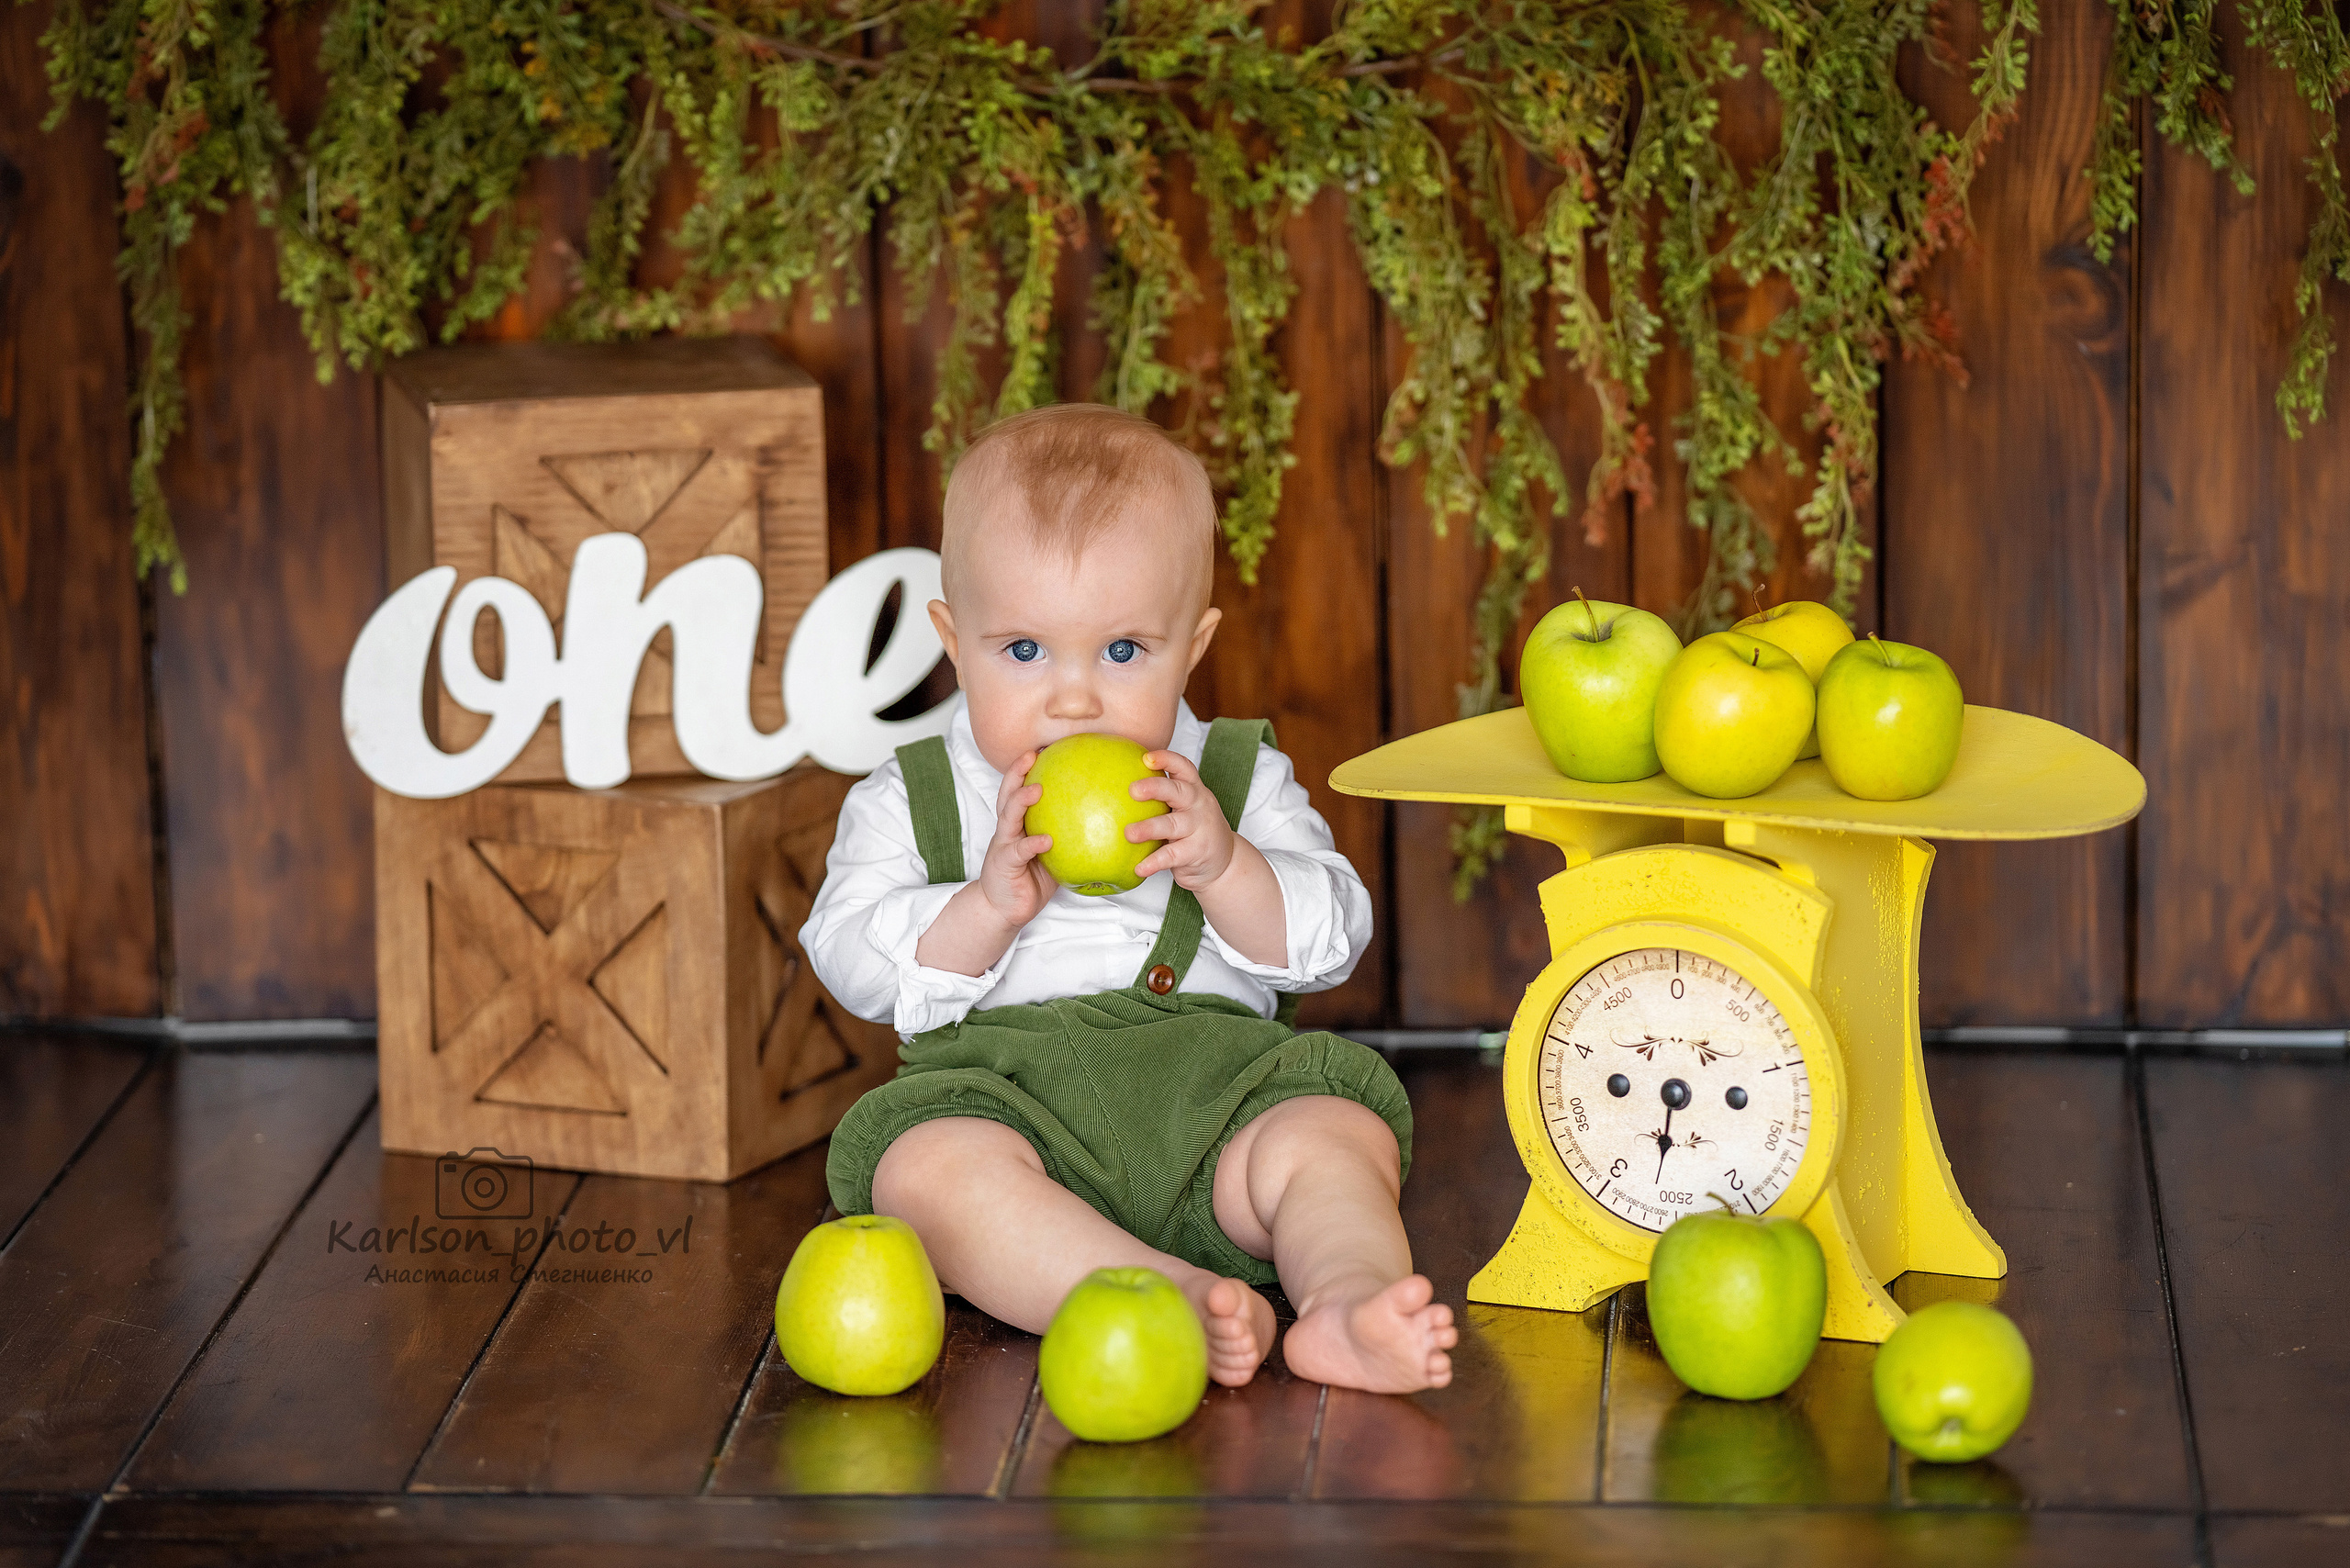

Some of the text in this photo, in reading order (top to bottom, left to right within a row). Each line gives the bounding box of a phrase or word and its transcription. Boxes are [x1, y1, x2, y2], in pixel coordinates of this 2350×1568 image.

[341, 532, 965, 800] one
[1672, 979, 1684, 999] 0
[1603, 987, 1632, 1011] 4500
[1726, 1000, 1750, 1022] 500
[1565, 1022, 1575, 1035] 4100
[1574, 1043, 1594, 1059] 4
[1762, 1062, 1781, 1072] 1
[1570, 1098, 1589, 1132] 3500
[1764, 1119, 1784, 1151] 1500
[1579, 1154, 1592, 1168] 3200
[1610, 1159, 1628, 1178] 3
[1589, 1166, 1602, 1180] 3100
[1725, 1169, 1743, 1190] 2
[1660, 1191, 1693, 1204] 2500
